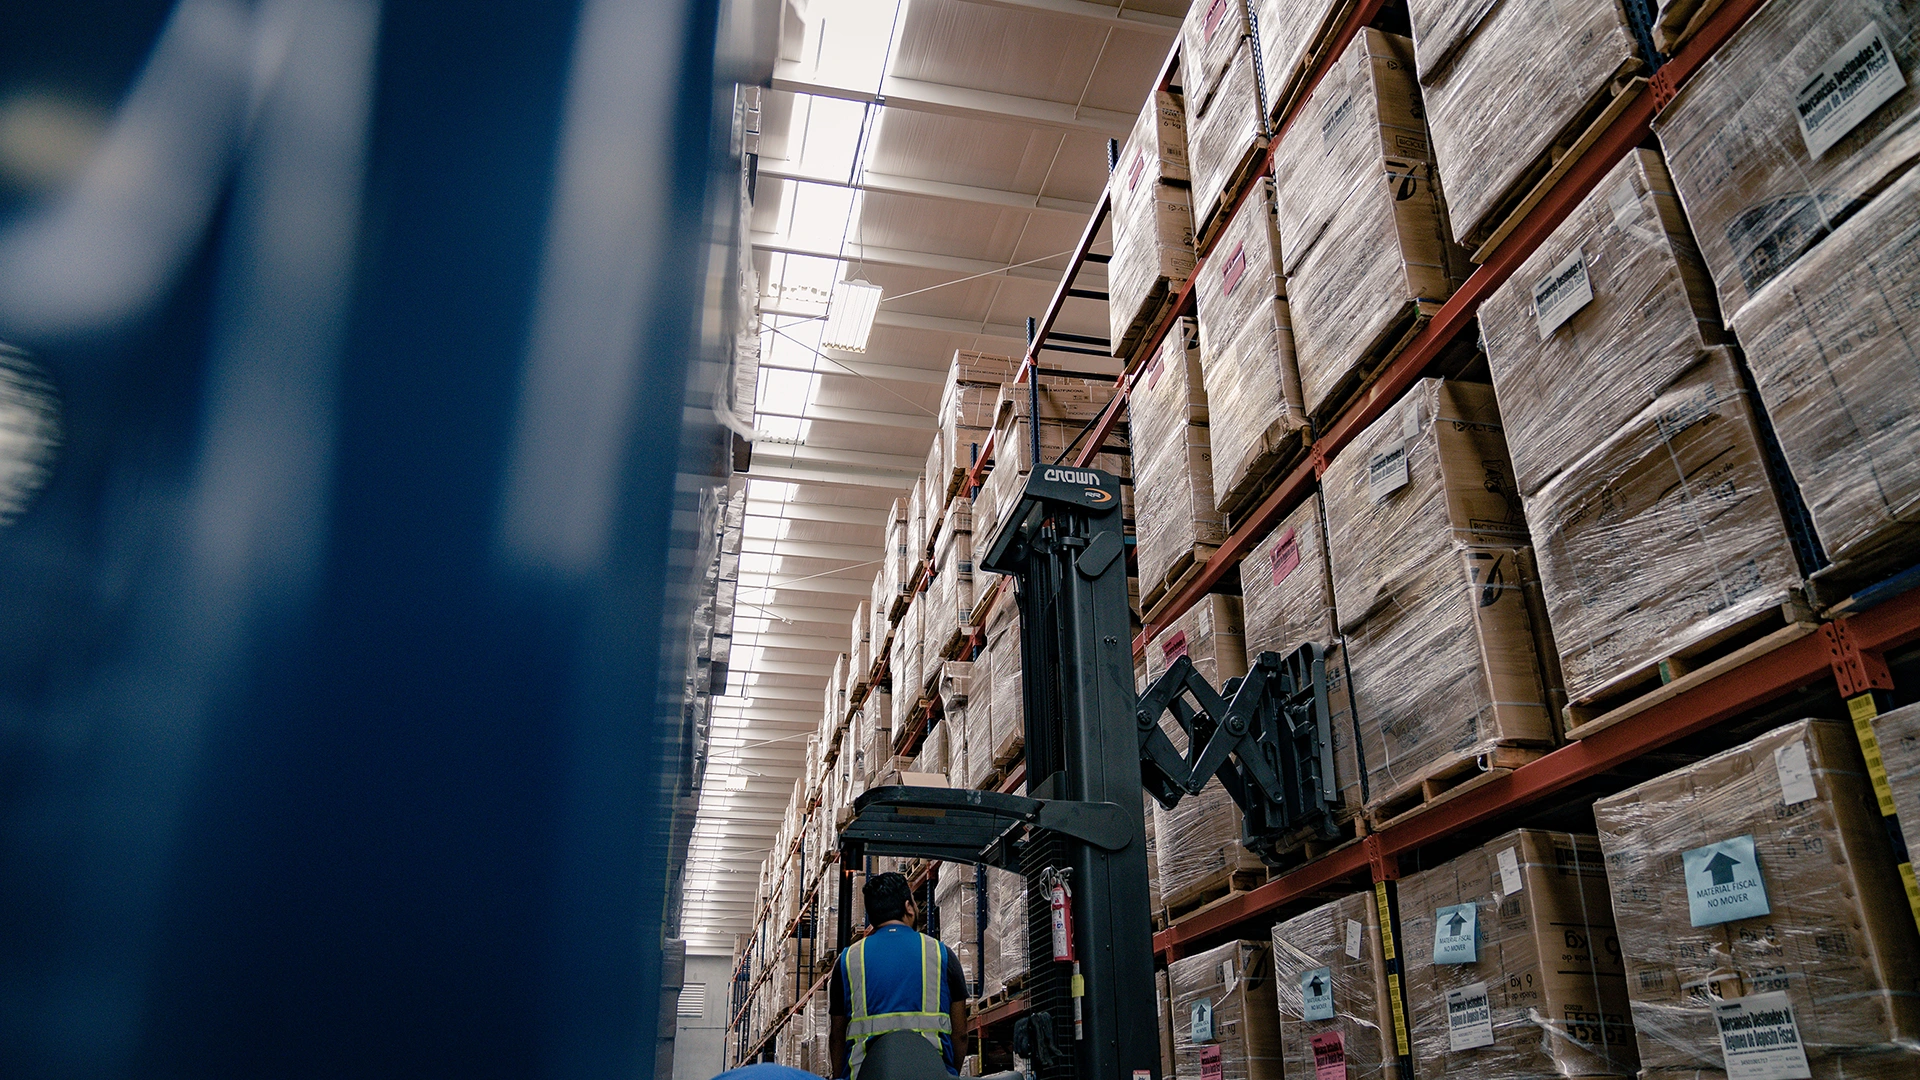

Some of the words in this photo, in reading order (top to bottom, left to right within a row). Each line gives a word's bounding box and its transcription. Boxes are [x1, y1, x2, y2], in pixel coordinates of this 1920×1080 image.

[1044, 468, 1100, 486] CROWN
[1697, 885, 1730, 898] MATERIAL
[1732, 878, 1757, 891] FISCAL
[1707, 897, 1719, 908] NO
[1720, 893, 1749, 906] MOVER
[1451, 943, 1466, 952] MOVER
[1510, 974, 1523, 991] kg
[1526, 973, 1533, 988] 6
[1777, 1024, 1798, 1045] Fiscal
